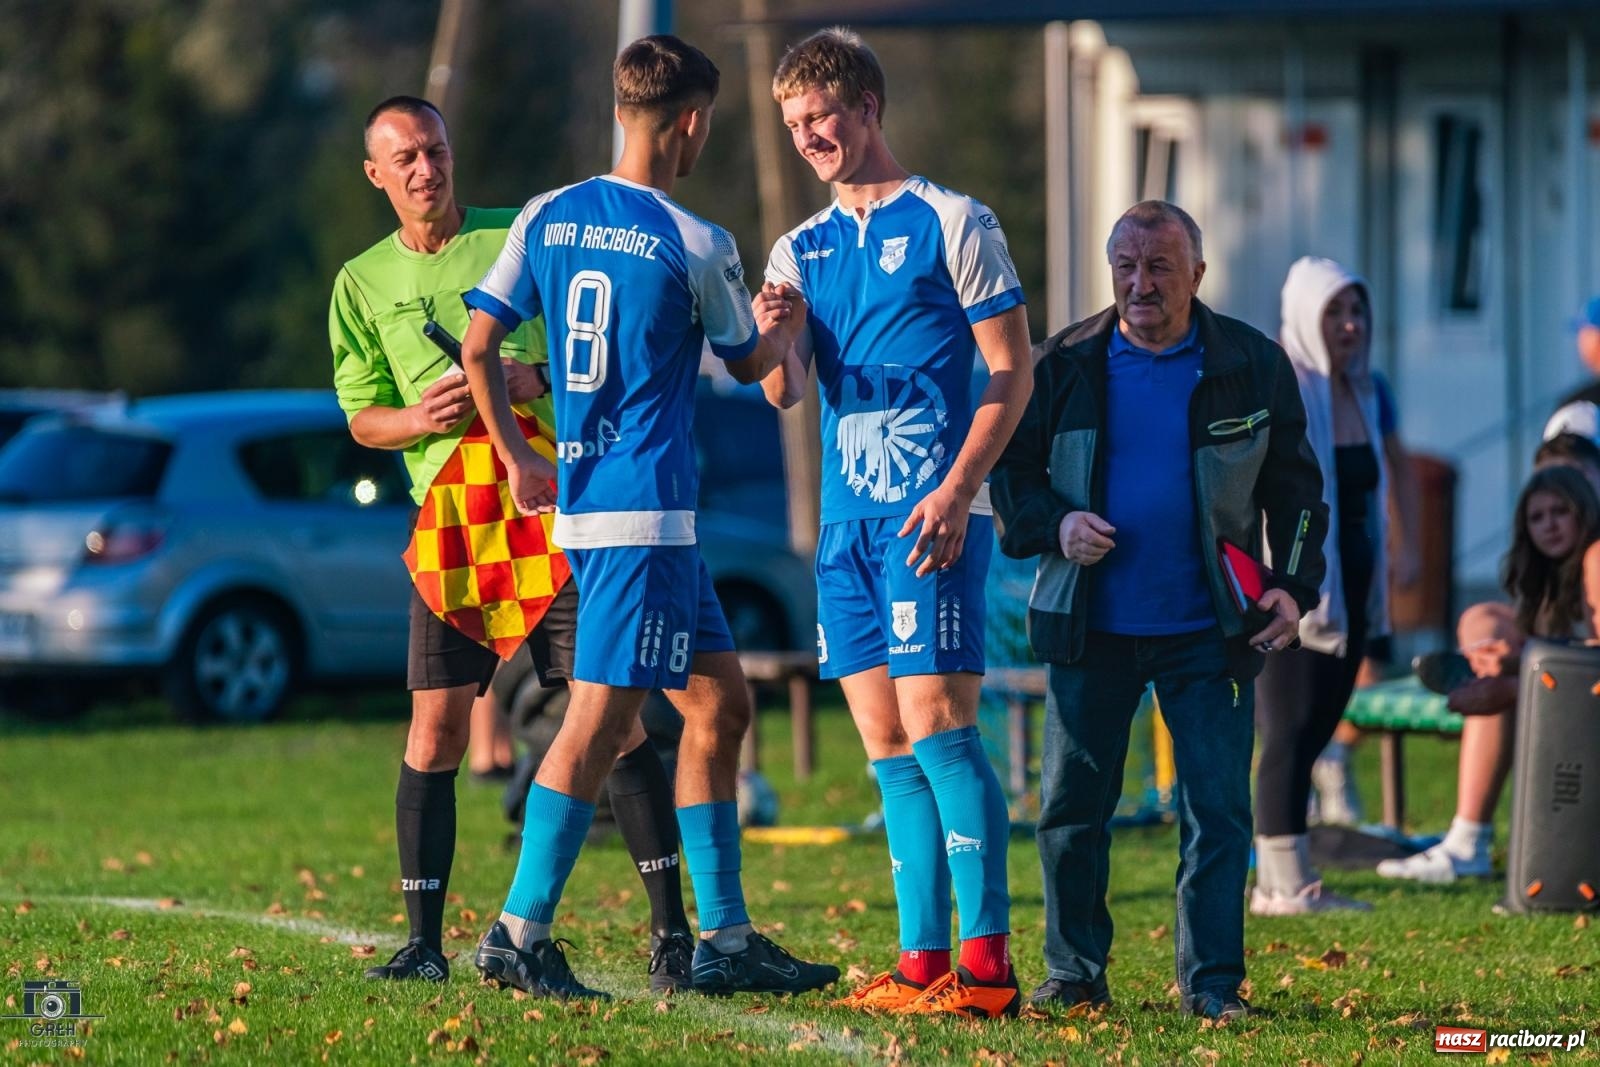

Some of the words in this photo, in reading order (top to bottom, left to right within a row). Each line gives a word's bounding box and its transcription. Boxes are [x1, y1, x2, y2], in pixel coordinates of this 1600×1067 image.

[544, 222, 578, 247] UNIA
[580, 224, 661, 260] RACIBÓRZ
[566, 270, 612, 393] 8
[669, 632, 690, 672] 8
[1552, 762, 1583, 813] JBL
